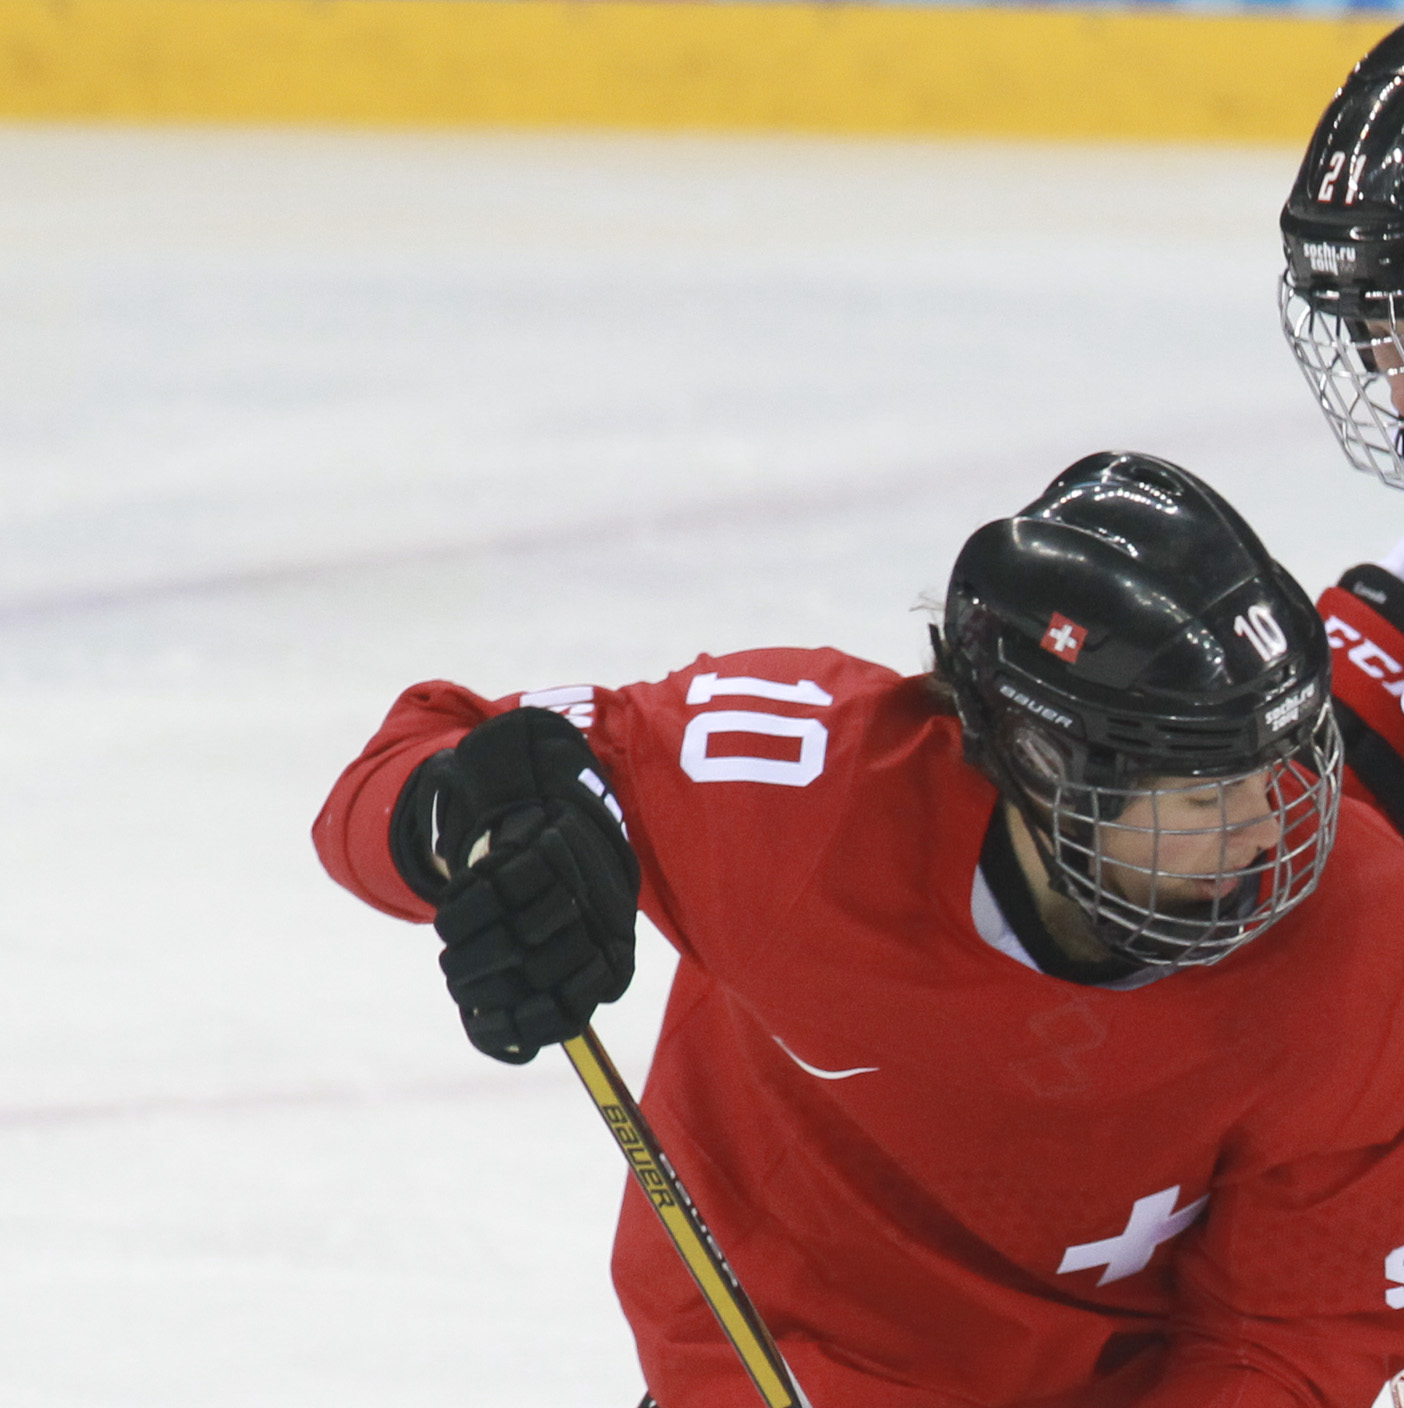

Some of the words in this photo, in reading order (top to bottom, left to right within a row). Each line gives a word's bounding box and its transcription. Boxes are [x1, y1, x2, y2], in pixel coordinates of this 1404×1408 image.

[1318, 150, 1367, 206] 21
[1234, 605, 1288, 662] 10
[679, 673, 833, 787] 10
